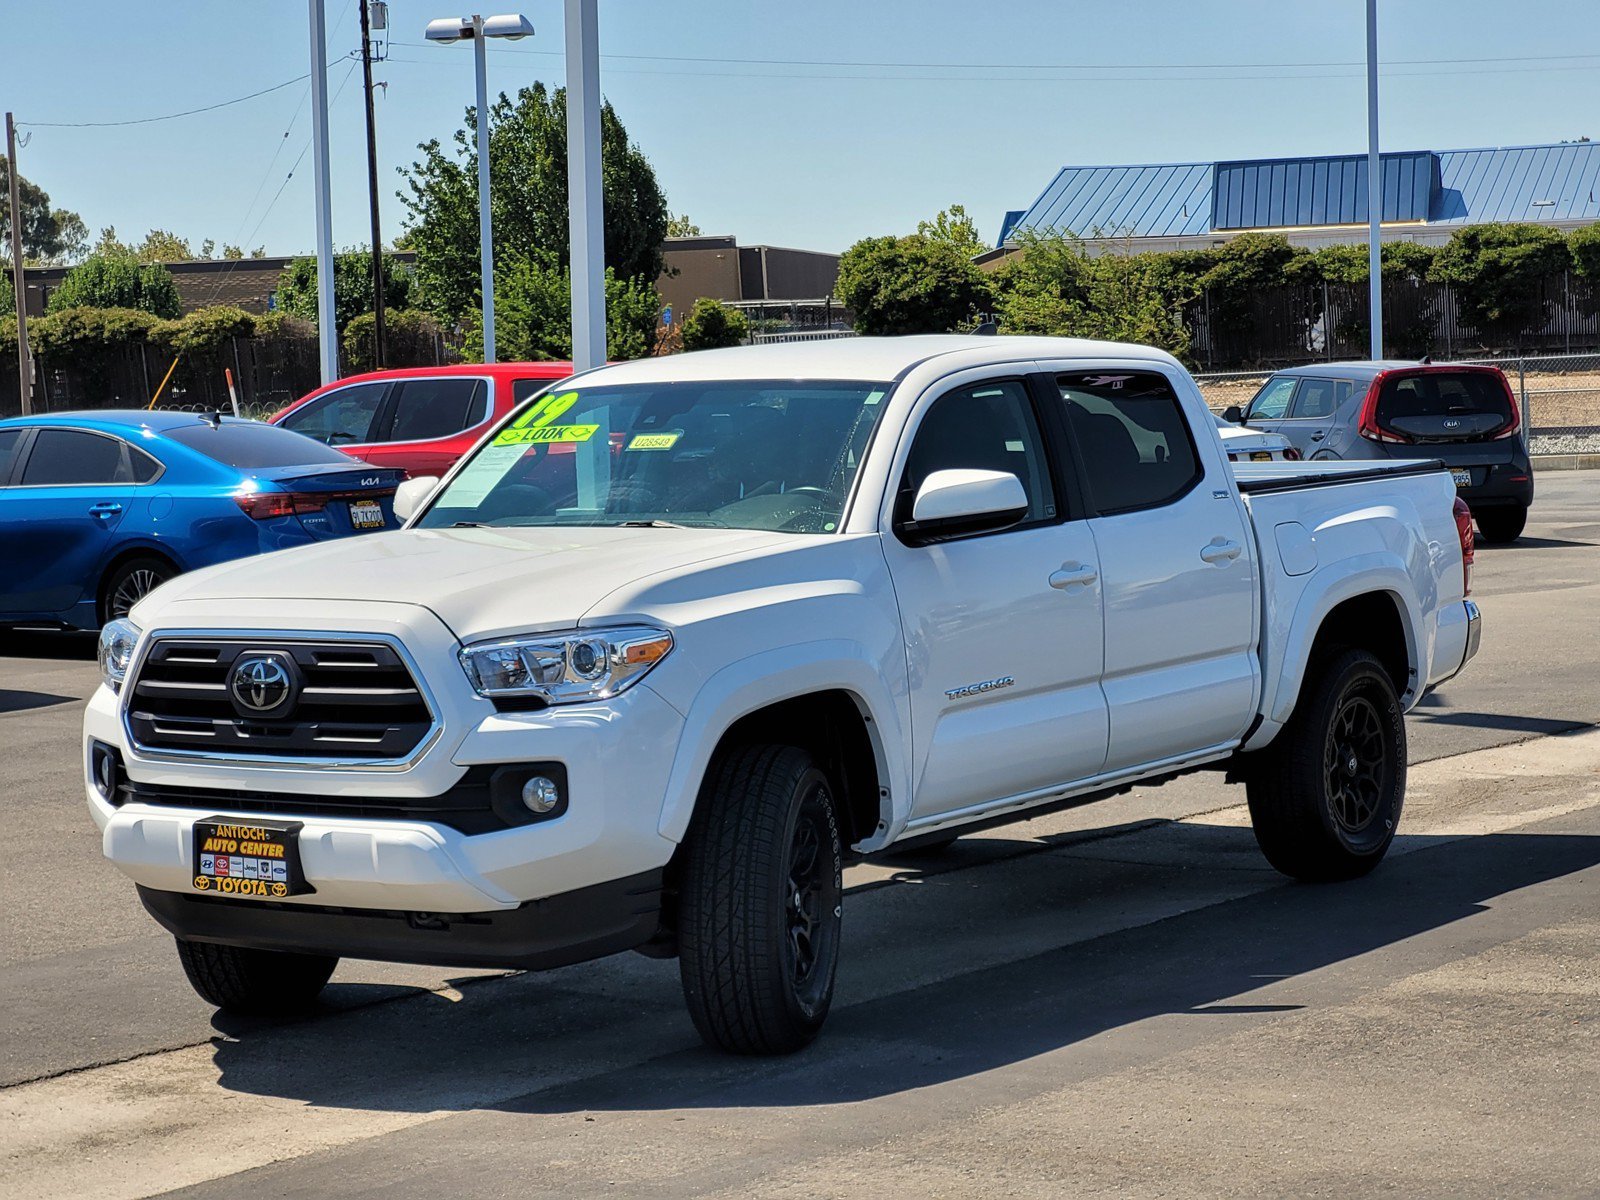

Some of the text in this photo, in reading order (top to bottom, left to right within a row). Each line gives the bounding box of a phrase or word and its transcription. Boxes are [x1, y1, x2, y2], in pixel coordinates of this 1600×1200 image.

[512, 391, 579, 429] 19
[520, 427, 569, 442] LOOK
[634, 438, 670, 448] U28549
[944, 675, 1015, 700] TACOMA
[216, 824, 266, 840] ANTIOCH
[203, 838, 285, 858] AUTO CENTER
[215, 877, 268, 896] TOYOTA
